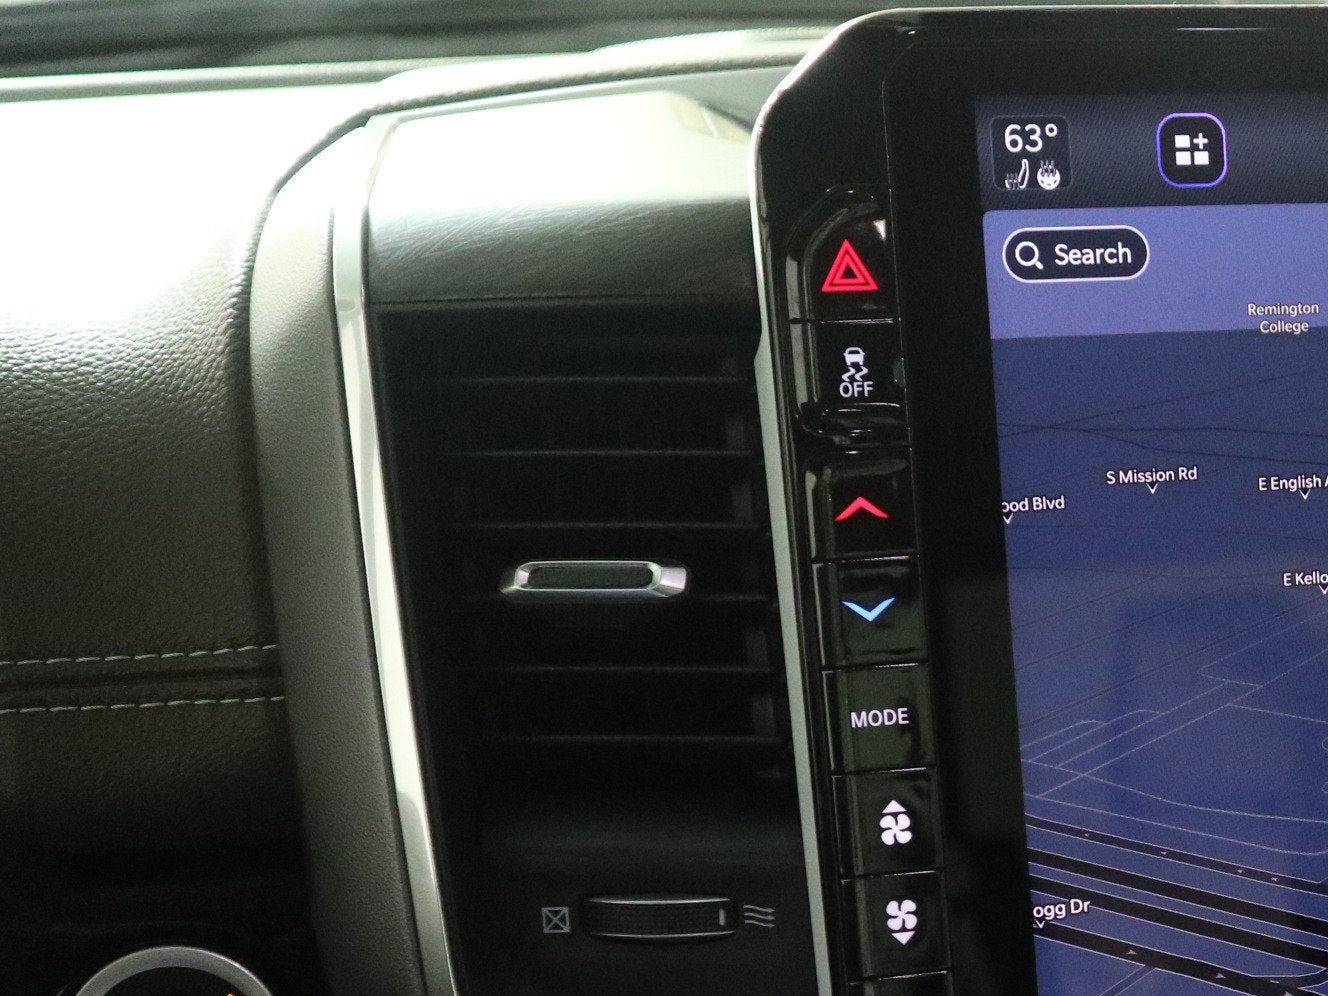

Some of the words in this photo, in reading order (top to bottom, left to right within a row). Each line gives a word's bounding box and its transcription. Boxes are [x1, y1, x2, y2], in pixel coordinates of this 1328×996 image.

[1054, 242, 1132, 266] Search
[1247, 302, 1319, 318] Remington
[1259, 319, 1309, 334] College
[839, 381, 874, 398] OFF
[1106, 470, 1116, 485] S
[1119, 468, 1175, 484] Mission
[1178, 466, 1198, 481] Rd
[1258, 477, 1267, 491] E
[1270, 475, 1322, 491] English
[1032, 494, 1065, 511] Blvd
[1283, 573, 1292, 586] E
[850, 707, 909, 728] MODE
[1070, 898, 1091, 914] Dr
